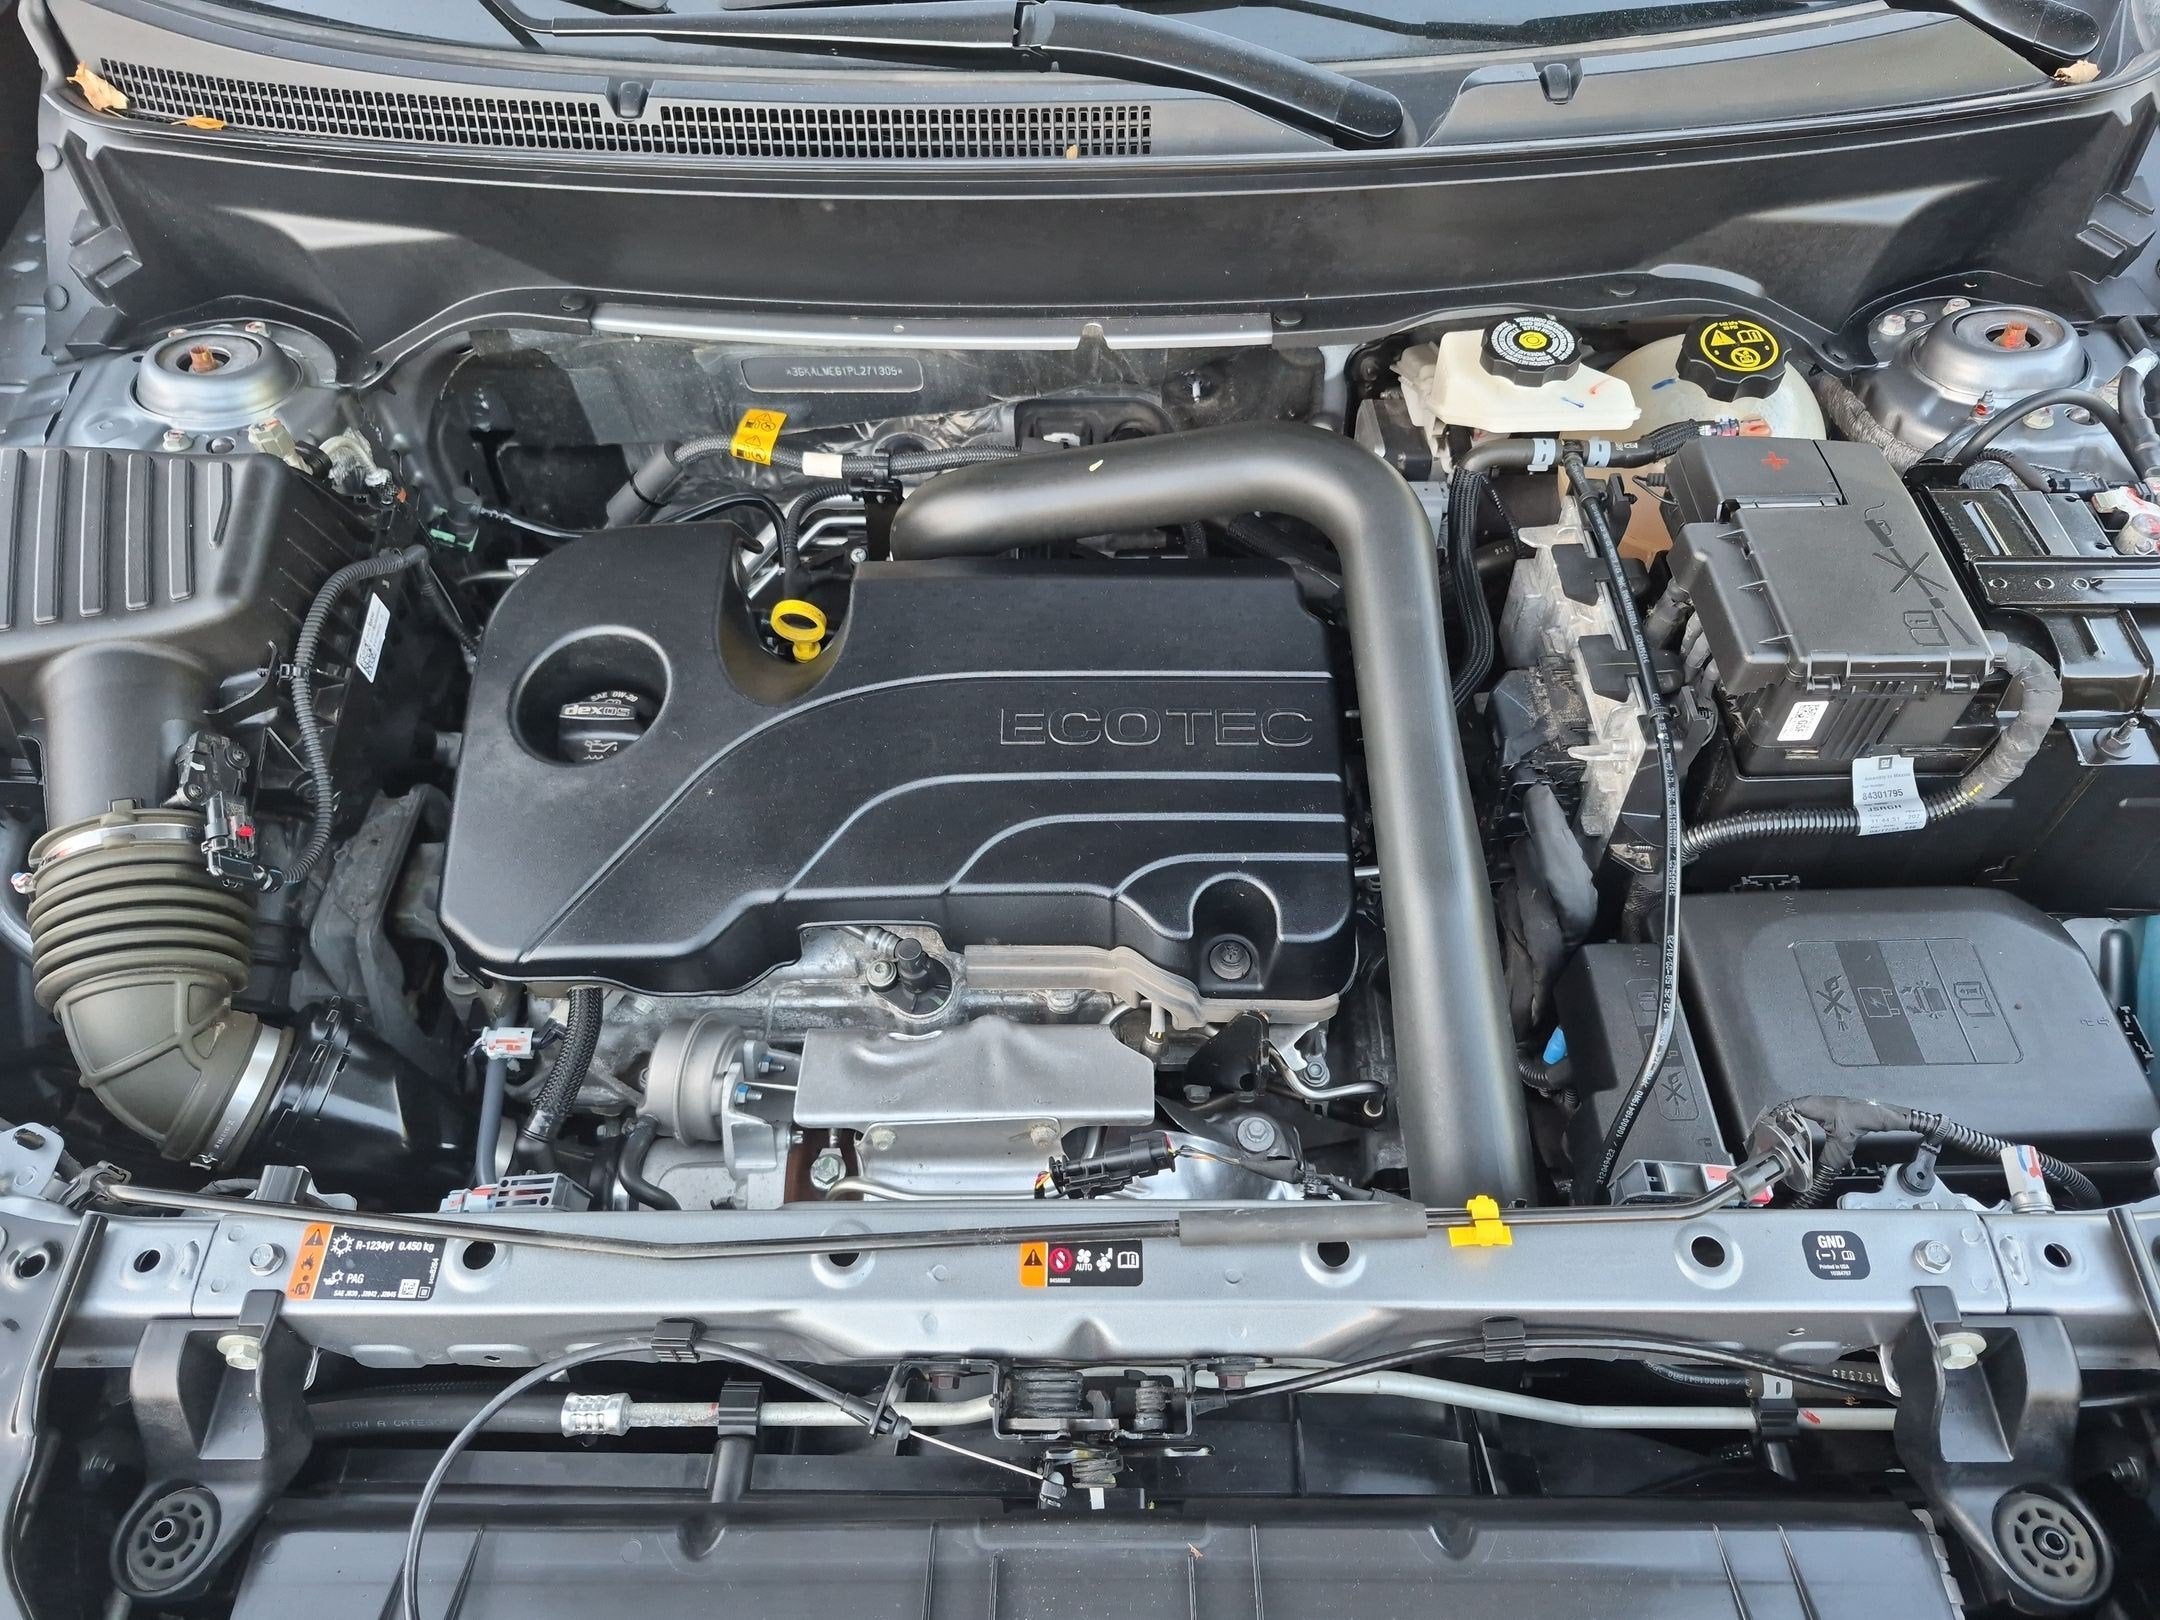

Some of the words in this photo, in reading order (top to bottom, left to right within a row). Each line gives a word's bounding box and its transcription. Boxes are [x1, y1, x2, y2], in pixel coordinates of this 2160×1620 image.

[590, 691, 608, 702] SAE
[612, 690, 639, 703] 0W-20
[563, 704, 631, 716] dexos
[1000, 706, 1313, 747] ECOTEC
[1862, 788, 1904, 801] 84301795
[355, 1240, 395, 1252] R-1234yf
[398, 1241, 423, 1251] 0.450
[422, 1241, 435, 1253] kg
[1817, 1235, 1846, 1249] GND
[1074, 1263, 1093, 1271] AUTO
[346, 1273, 365, 1284] PAG
